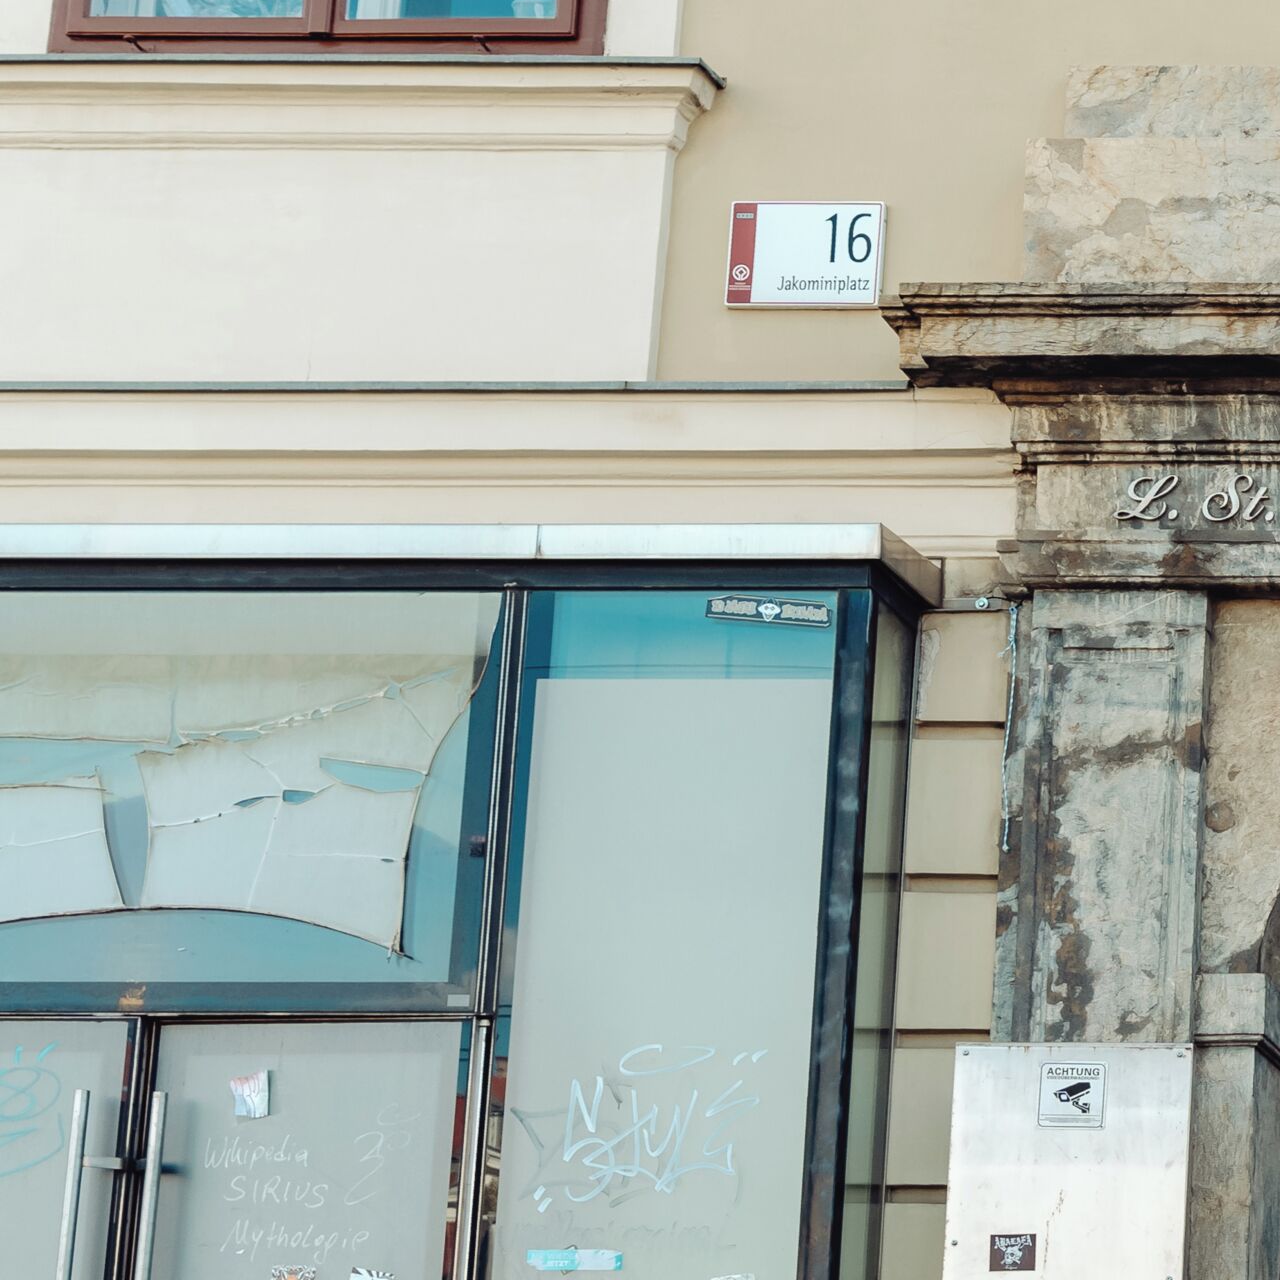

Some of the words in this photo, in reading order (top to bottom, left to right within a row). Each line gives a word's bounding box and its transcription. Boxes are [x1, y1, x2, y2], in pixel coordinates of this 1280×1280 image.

[826, 212, 872, 263] 16
[777, 275, 870, 295] Jakominiplatz
[1113, 474, 1179, 521] L.
[1202, 474, 1275, 521] St.
[1046, 1067, 1100, 1076] ACHTUNG
[203, 1134, 309, 1171] Wikipedia
[223, 1174, 329, 1208] SIRIUS
[219, 1218, 370, 1264] Mythologie
